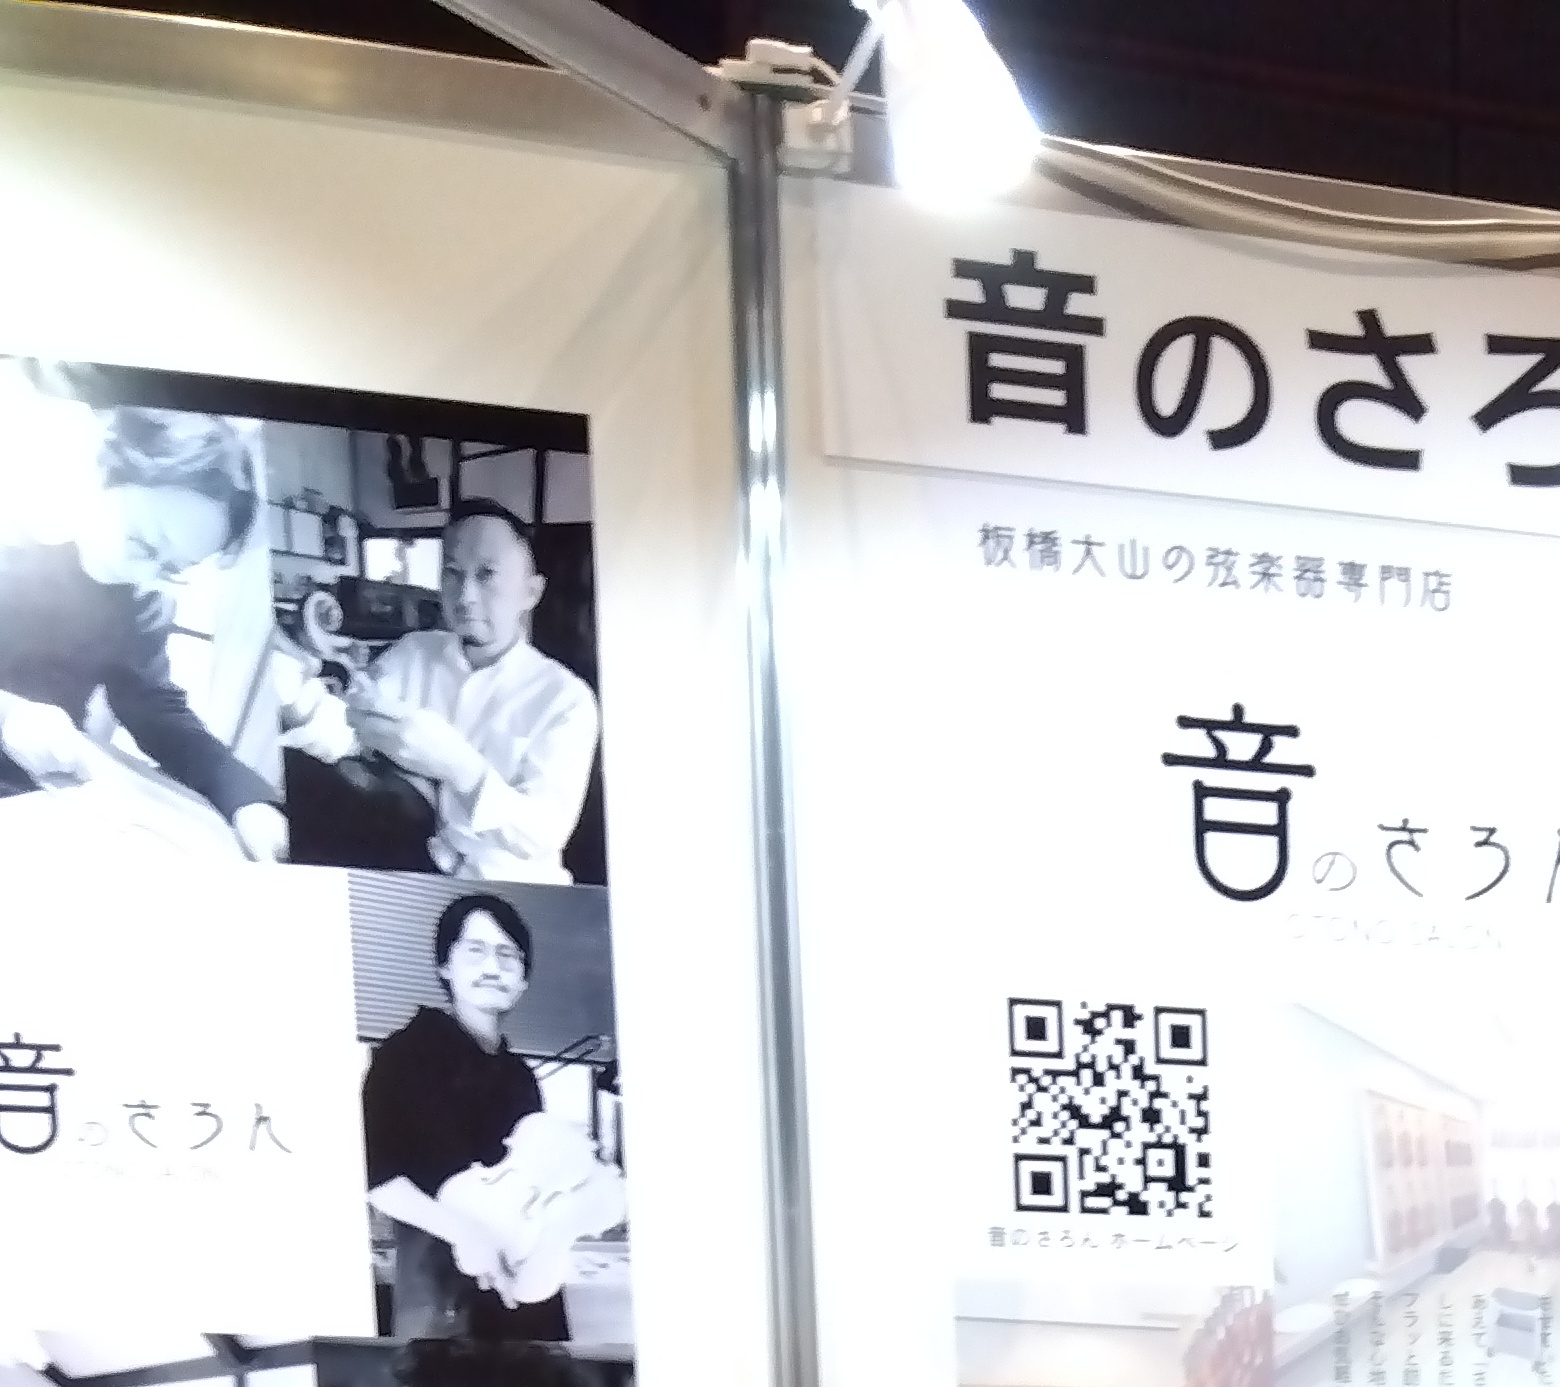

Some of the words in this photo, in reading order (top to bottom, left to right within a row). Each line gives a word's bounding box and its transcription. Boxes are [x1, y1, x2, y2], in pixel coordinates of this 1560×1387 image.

[978, 522, 1453, 612] 板橋大山の弦楽器専門店
